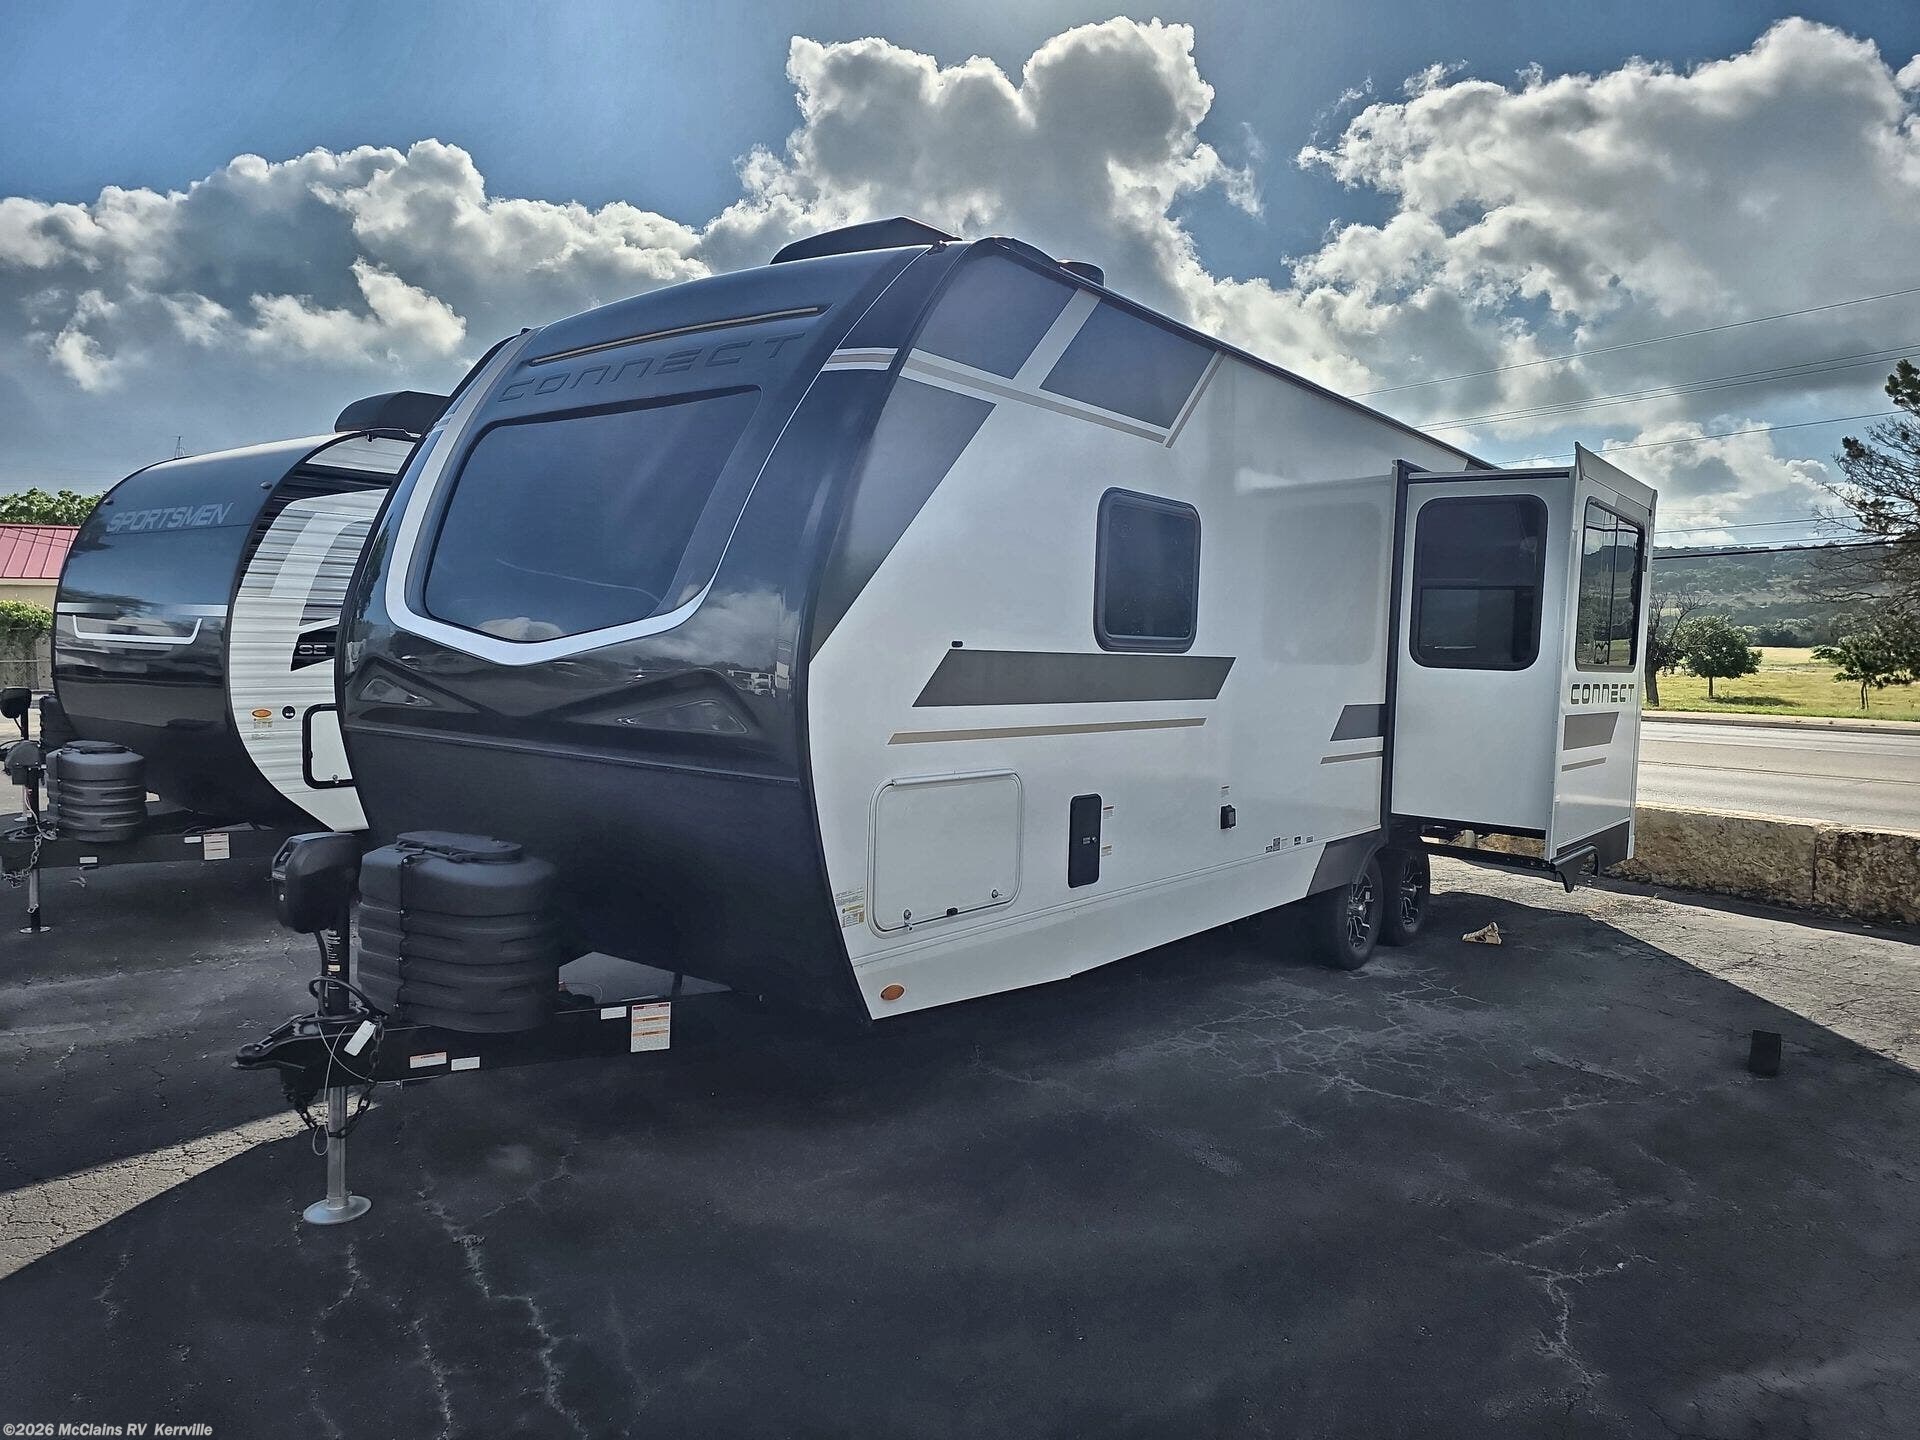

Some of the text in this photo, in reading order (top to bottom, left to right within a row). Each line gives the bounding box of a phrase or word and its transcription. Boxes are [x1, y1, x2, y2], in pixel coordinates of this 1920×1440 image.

[498, 332, 806, 402] CONNECT
[106, 502, 234, 533] SPORTSMEN
[299, 644, 327, 655] SE
[1571, 684, 1634, 704] CONNECT
